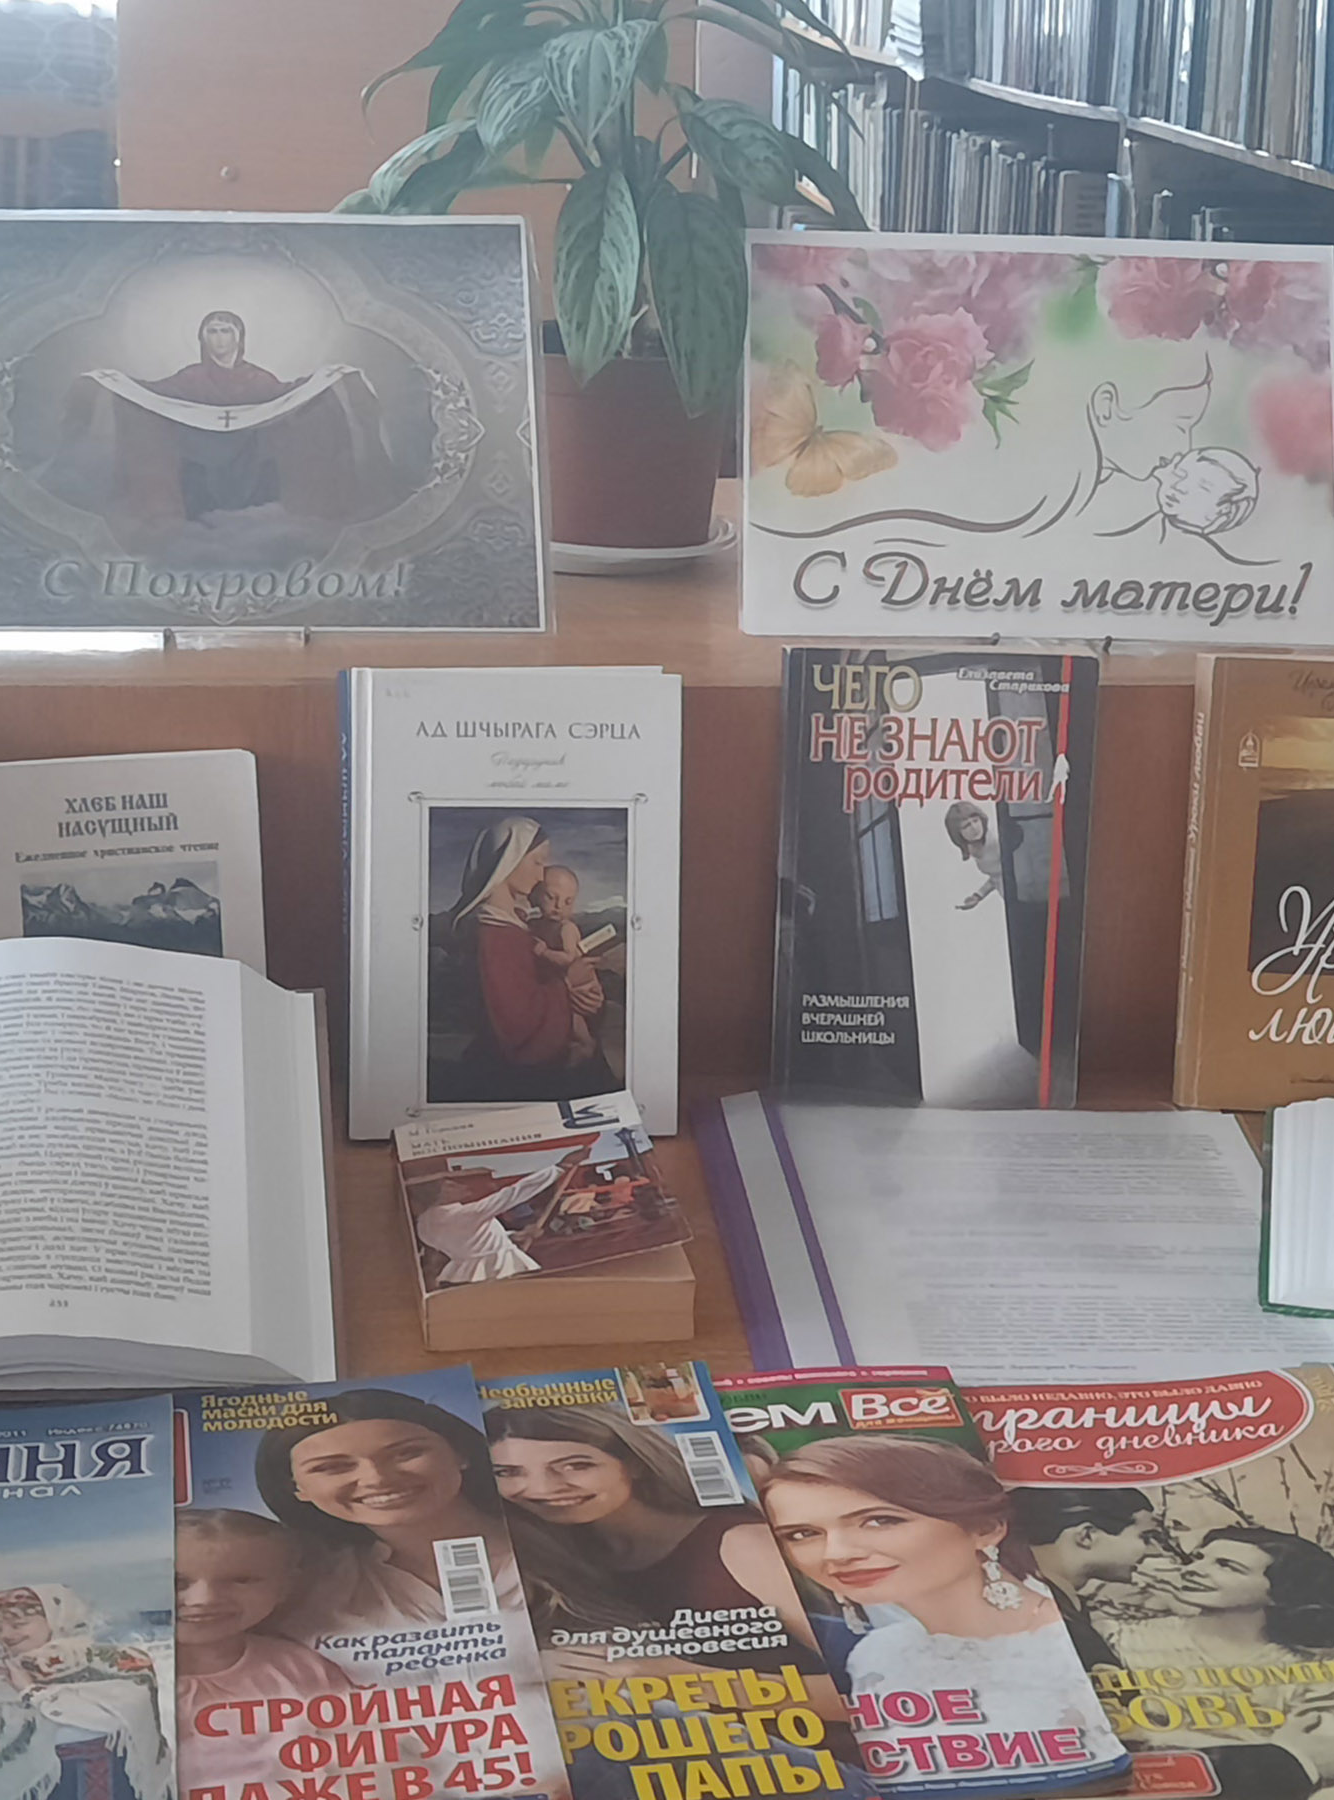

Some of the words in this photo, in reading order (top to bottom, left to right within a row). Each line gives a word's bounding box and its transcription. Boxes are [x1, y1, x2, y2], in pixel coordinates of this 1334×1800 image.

[42, 560, 81, 599] С
[102, 558, 413, 611] Покровом!
[793, 551, 847, 606] С
[862, 552, 1043, 608] Днём
[1061, 561, 1314, 627] матери!
[813, 664, 922, 712] ЧЕГО
[417, 721, 448, 738] АД
[455, 721, 558, 739] ШЧЫРАГА
[568, 721, 641, 740] СЭРЦА
[810, 714, 869, 762] НЕ
[879, 716, 1045, 765] ЗНАЮТ
[65, 796, 116, 814] ХЛЕБ
[121, 793, 168, 810] НАШ
[843, 765, 1043, 813] родители
[58, 813, 179, 838] НАСУЩНЫЙ
[802, 994, 910, 1009] РАЗМЫШЛЕНИЯ
[801, 1011, 885, 1027] ВЧЕРАШНЕЙ
[801, 1030, 895, 1046] ШКОЛЬНИЦЫ
[201, 1390, 309, 1408] Ягодные
[202, 1404, 278, 1421] маски
[281, 1400, 329, 1420] для
[500, 1391, 618, 1409] заготовки
[851, 1393, 952, 1421] Все
[202, 1411, 338, 1433] молодости
[1096, 1423, 1285, 1459] дневника
[670, 1605, 777, 1627] Диета
[314, 1633, 368, 1651] Как
[371, 1621, 502, 1652] развить
[550, 1629, 608, 1648] для
[611, 1617, 783, 1647] душевного
[607, 1632, 788, 1662] равновесия
[353, 1635, 504, 1663] таланты
[385, 1647, 507, 1676] ребенка
[194, 1673, 517, 1738] СТРОЙНАЯ
[279, 1713, 529, 1773] ФИГУРА
[860, 1728, 1090, 1776] СТВИЕ
[392, 1766, 434, 1800] В
[444, 1751, 537, 1793] 45!
[629, 1751, 845, 1800] ПАПЫ
